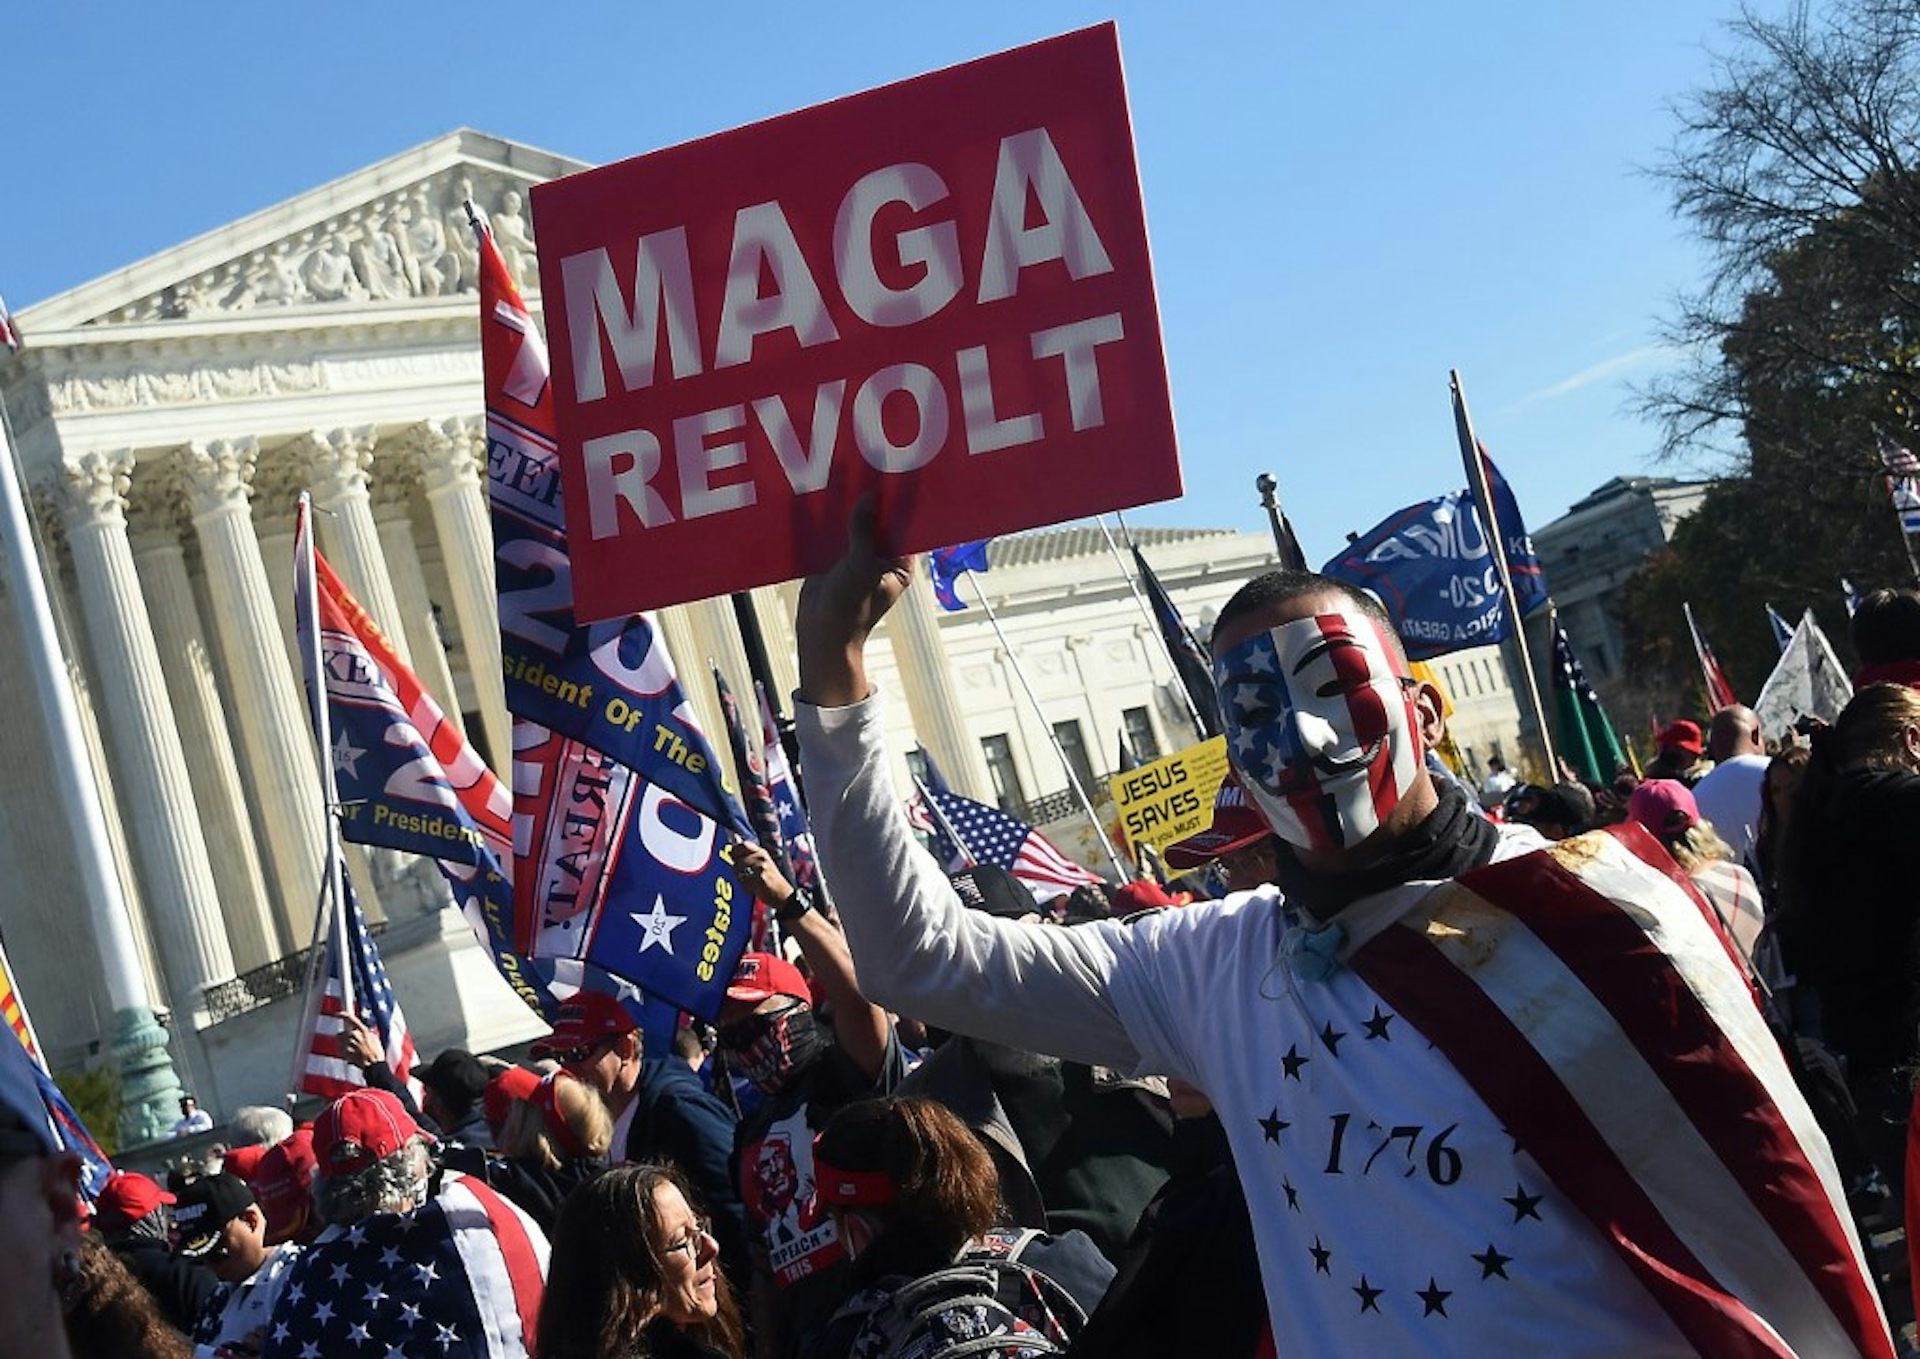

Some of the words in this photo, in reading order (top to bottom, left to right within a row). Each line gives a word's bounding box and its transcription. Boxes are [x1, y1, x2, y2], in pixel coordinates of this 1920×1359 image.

[559, 126, 1114, 403] MAGA
[583, 312, 1125, 540] REVOLT
[604, 697, 644, 734] Of
[652, 724, 708, 774] The
[1120, 759, 1188, 806] JESUS
[1126, 789, 1200, 836] SAVES
[1174, 816, 1201, 835] MUST
